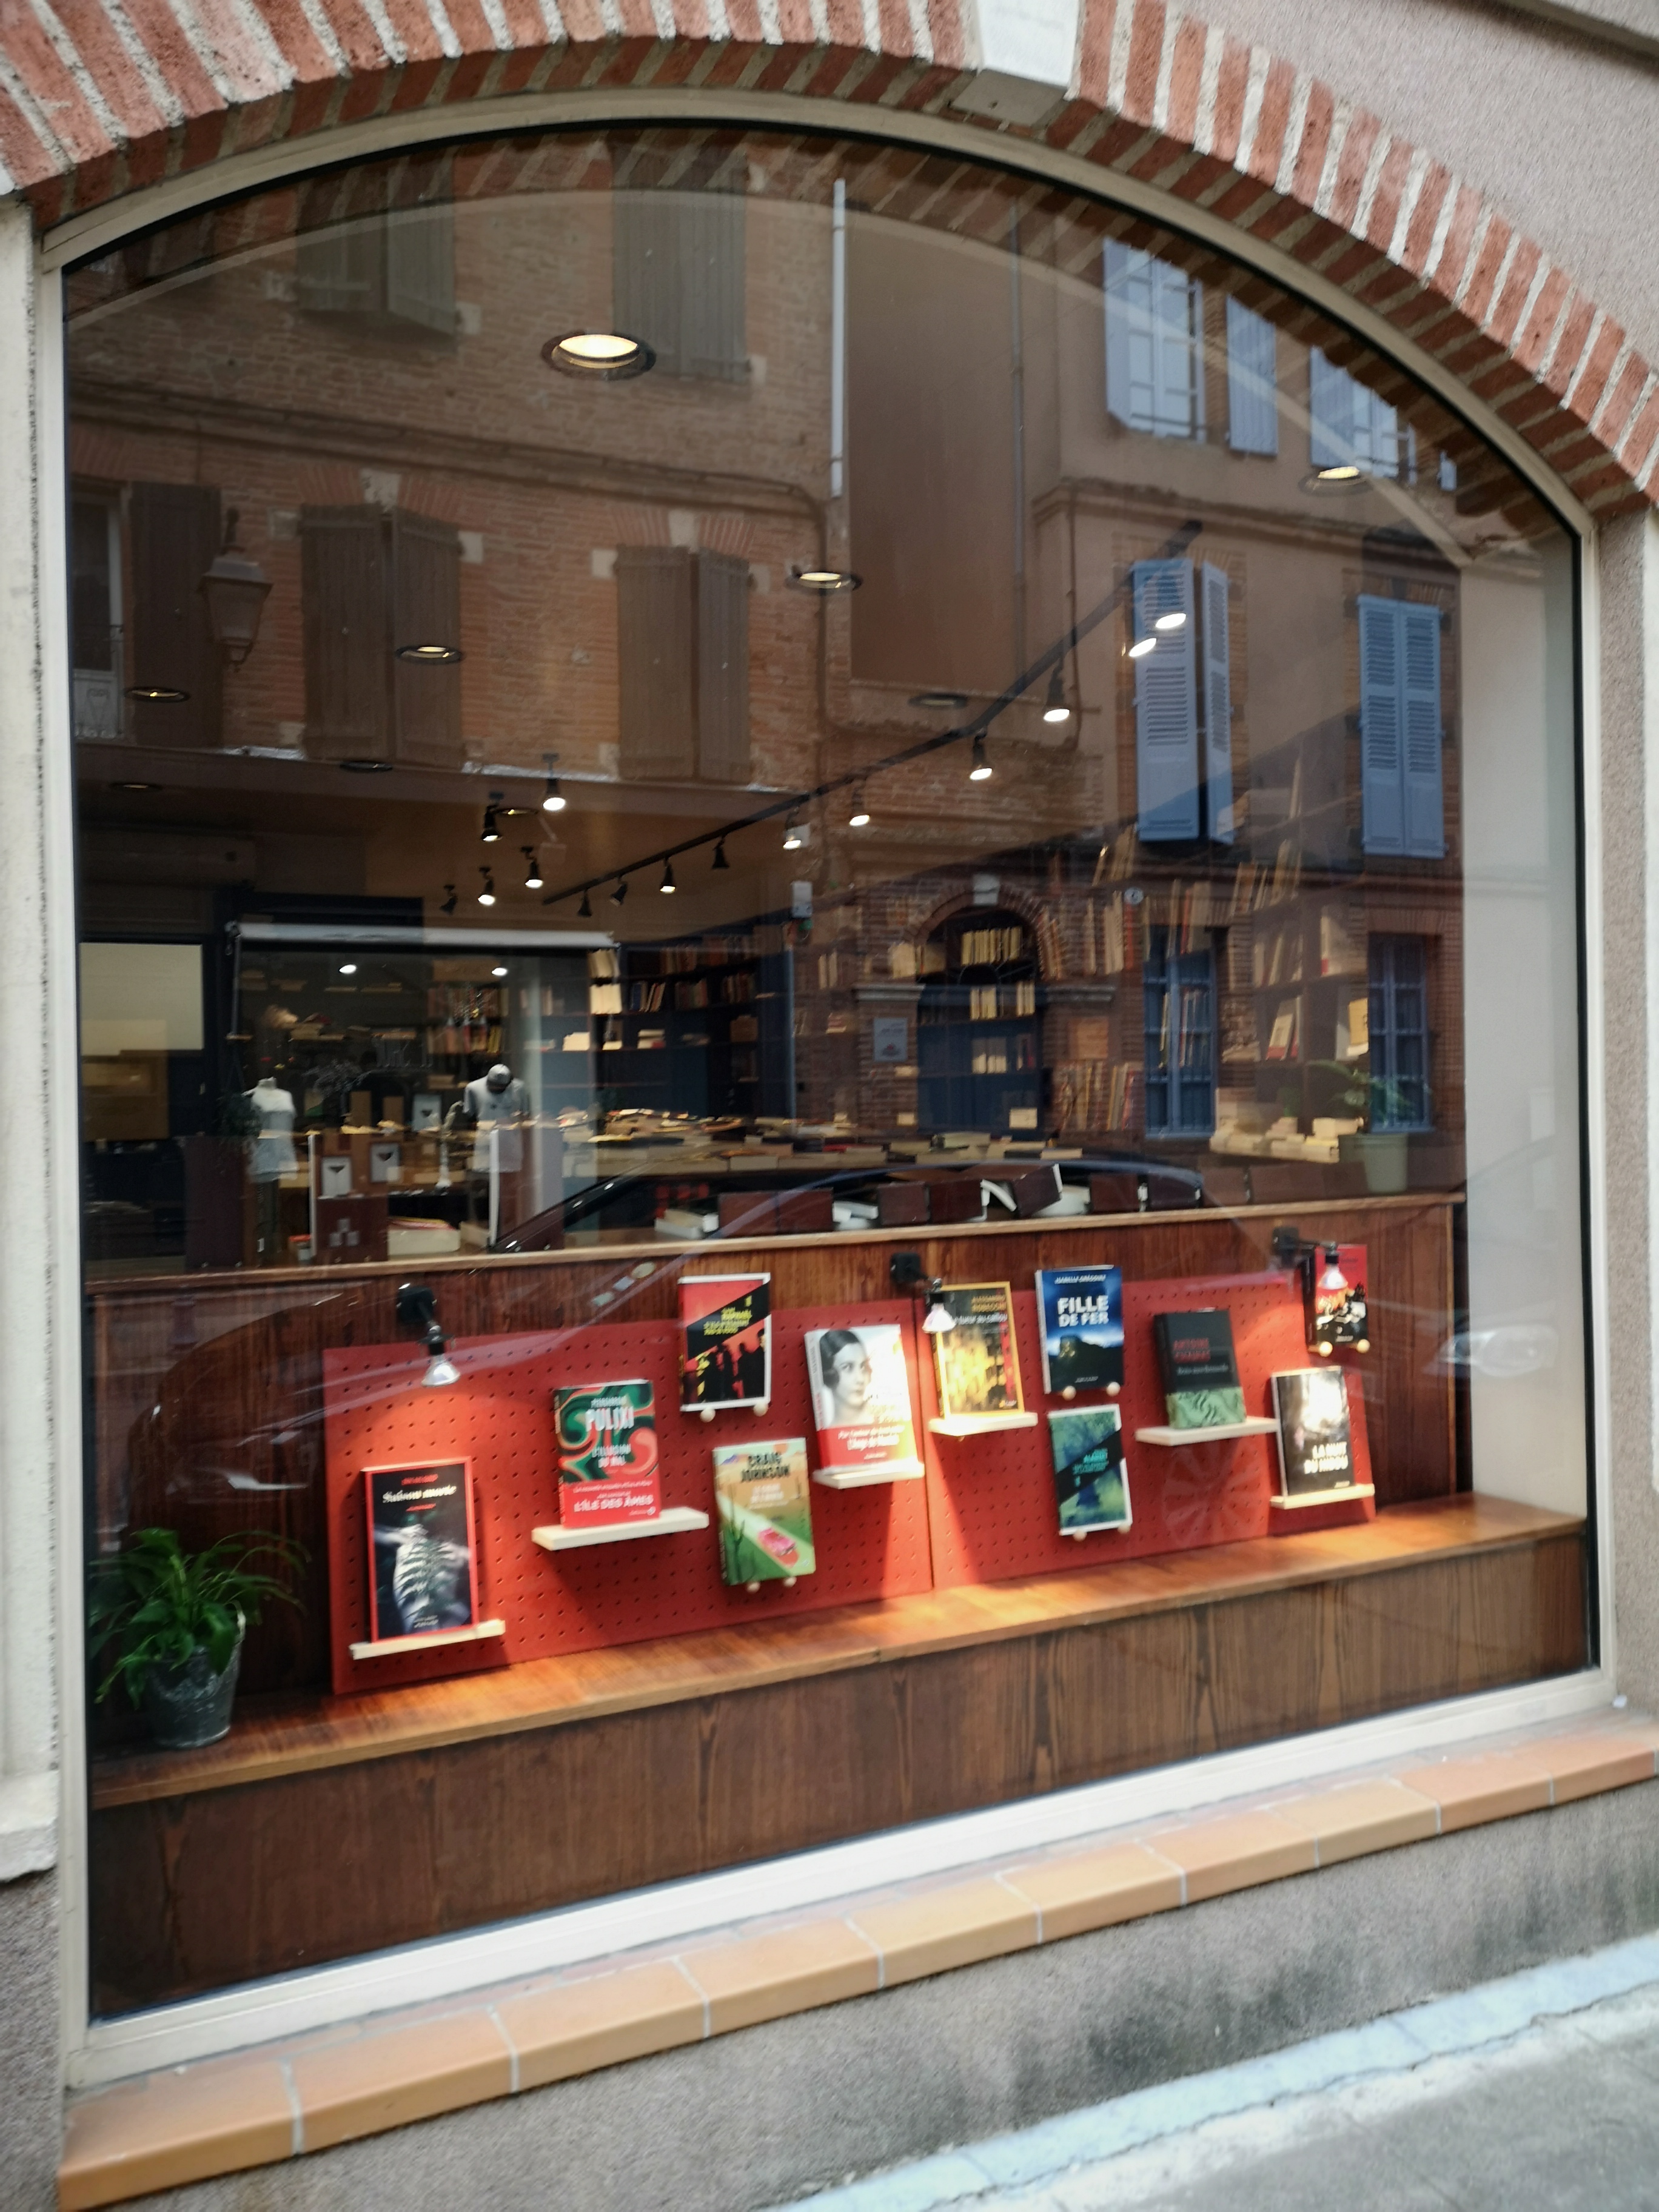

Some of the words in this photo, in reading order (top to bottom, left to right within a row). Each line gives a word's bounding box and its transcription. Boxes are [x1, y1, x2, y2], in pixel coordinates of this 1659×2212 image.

[1057, 1295, 1109, 1315] FILLE
[1059, 1313, 1079, 1327] DE
[1081, 1311, 1109, 1326] FER
[586, 1406, 634, 1432] PULIXI
[1312, 1444, 1326, 1459] LA
[748, 1452, 782, 1467] CRAIG
[1304, 1459, 1318, 1474] DU
[600, 1497, 623, 1509] DES
